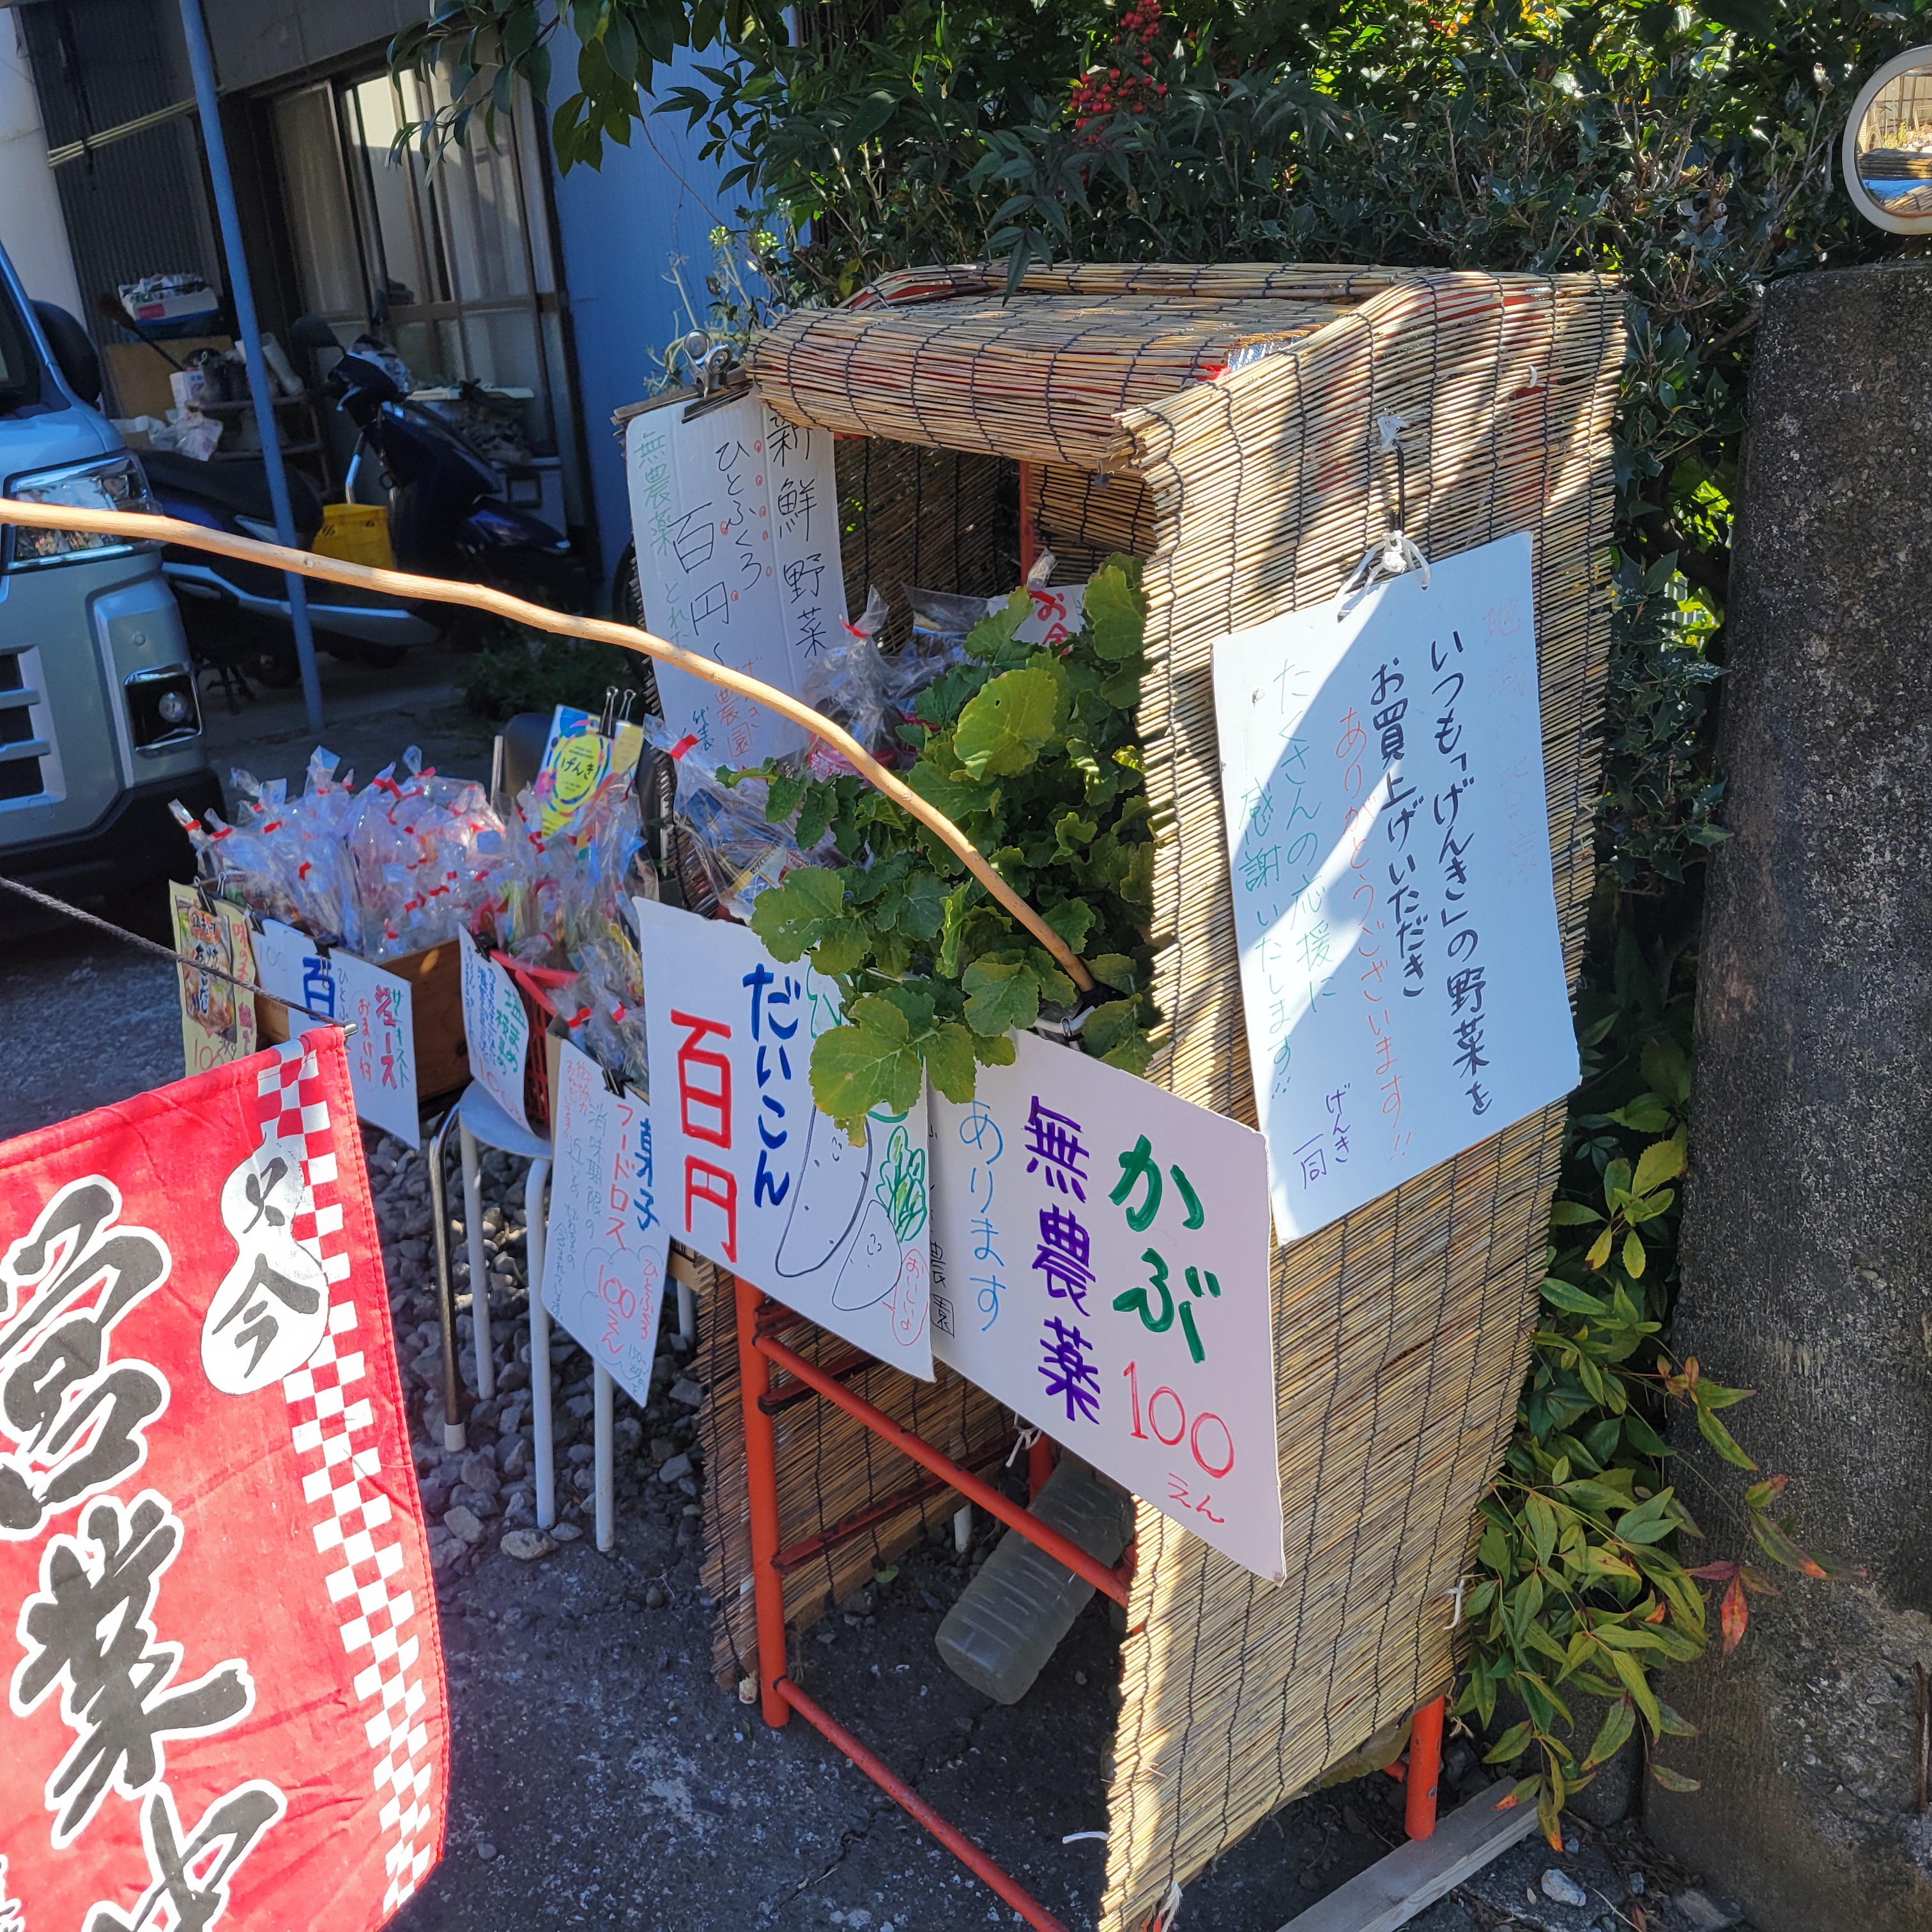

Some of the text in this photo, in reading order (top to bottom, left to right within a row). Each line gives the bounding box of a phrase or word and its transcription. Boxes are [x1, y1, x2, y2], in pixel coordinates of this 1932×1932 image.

[634, 431, 674, 556] 無農薬
[716, 440, 762, 590] ひとふくろ
[767, 417, 827, 659] 新鮮野菜
[561, 757, 595, 780] げんき
[1273, 658, 1336, 1012] たくさんの応援に
[1370, 657, 1429, 997] お買上げいただき
[1431, 630, 1493, 1116] いつも「げんき」の野菜を
[375, 985, 397, 1089] ジュース
[743, 963, 801, 1207] だいこん
[1326, 1082, 1351, 1162] げんき
[605, 1103, 636, 1252] フードロス
[671, 1008, 738, 1263] 百円
[959, 1100, 1008, 1332] あります
[1292, 1133, 1327, 1190] 一同
[212, 1156, 319, 1378] 只今
[598, 1264, 636, 1319] 100
[1022, 1096, 1100, 1425] 無農薬
[1108, 1134, 1222, 1363] かぶ
[1123, 1360, 1234, 1478] 100
[1167, 1471, 1225, 1524] えん
